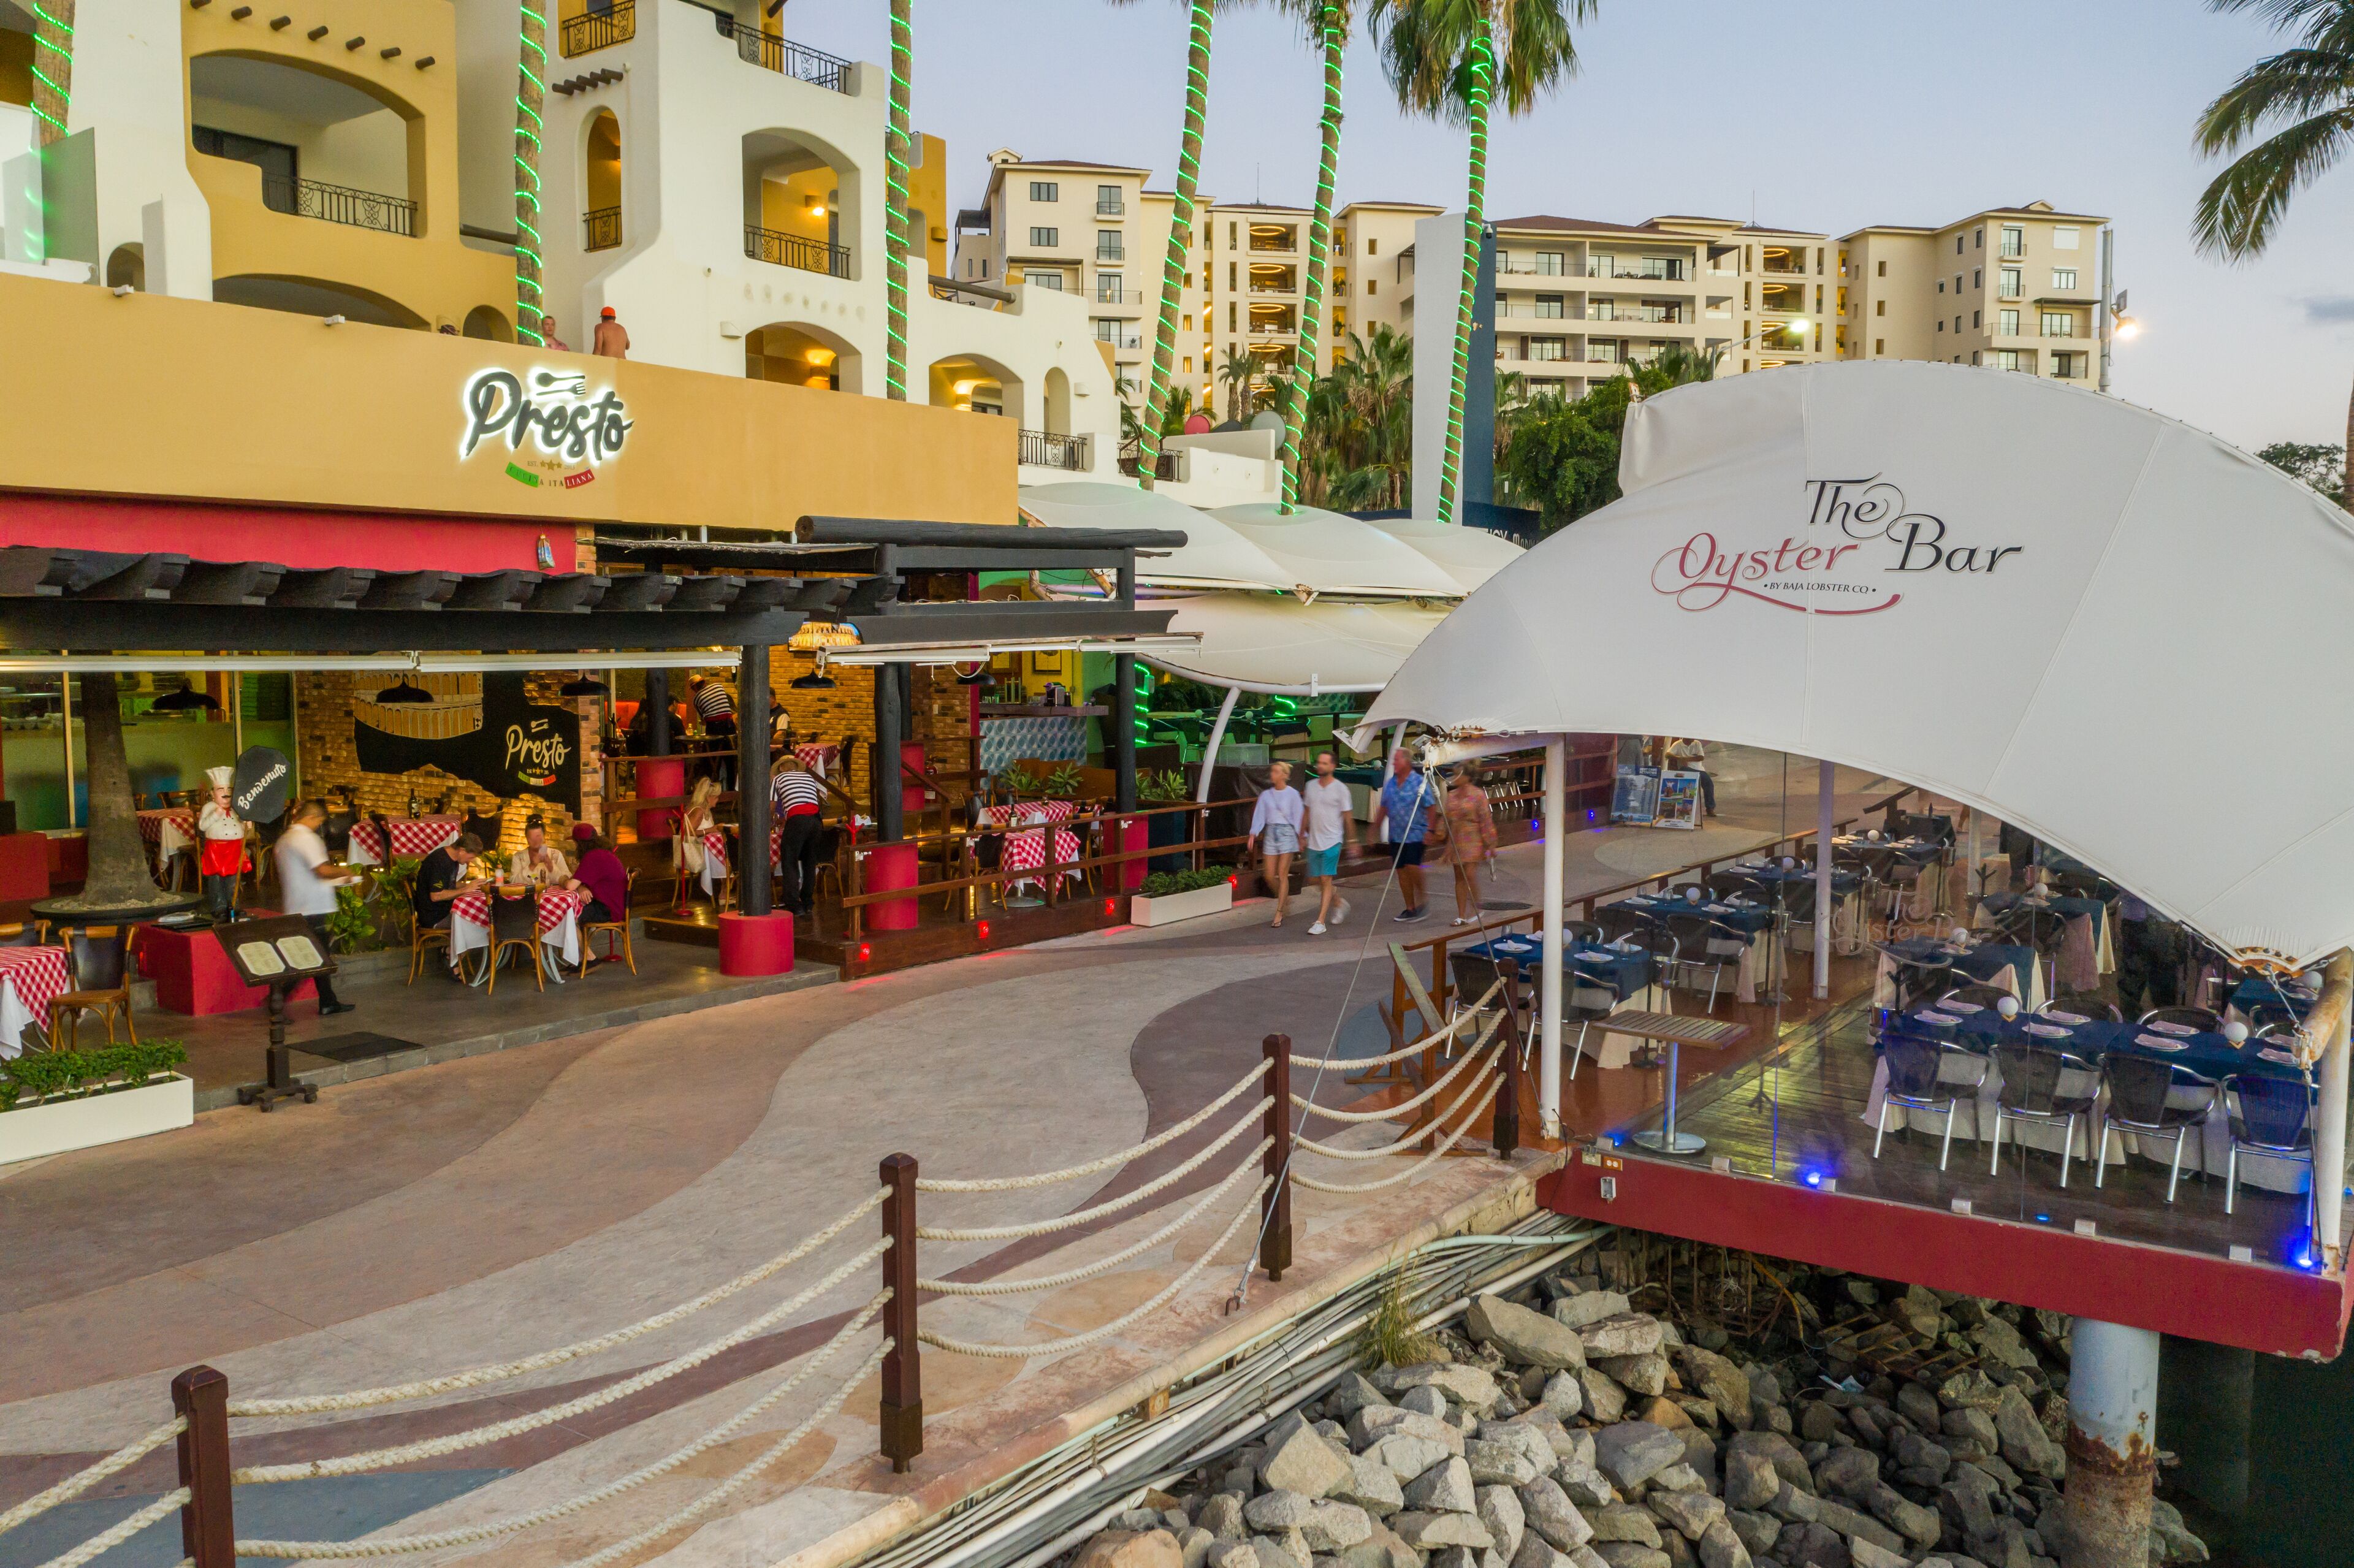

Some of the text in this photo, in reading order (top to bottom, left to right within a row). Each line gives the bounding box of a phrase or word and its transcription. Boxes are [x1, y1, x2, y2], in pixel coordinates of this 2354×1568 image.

[465, 371, 634, 461] Presto
[549, 473, 592, 487] ITALIANA
[1805, 472, 1904, 539] The
[1652, 514, 2023, 611] Oyster Bar
[1783, 582, 1804, 591] BAJA
[1807, 583, 1849, 592] LOBSTER
[505, 725, 571, 770] Presto
[237, 764, 286, 810] Benvenuto
